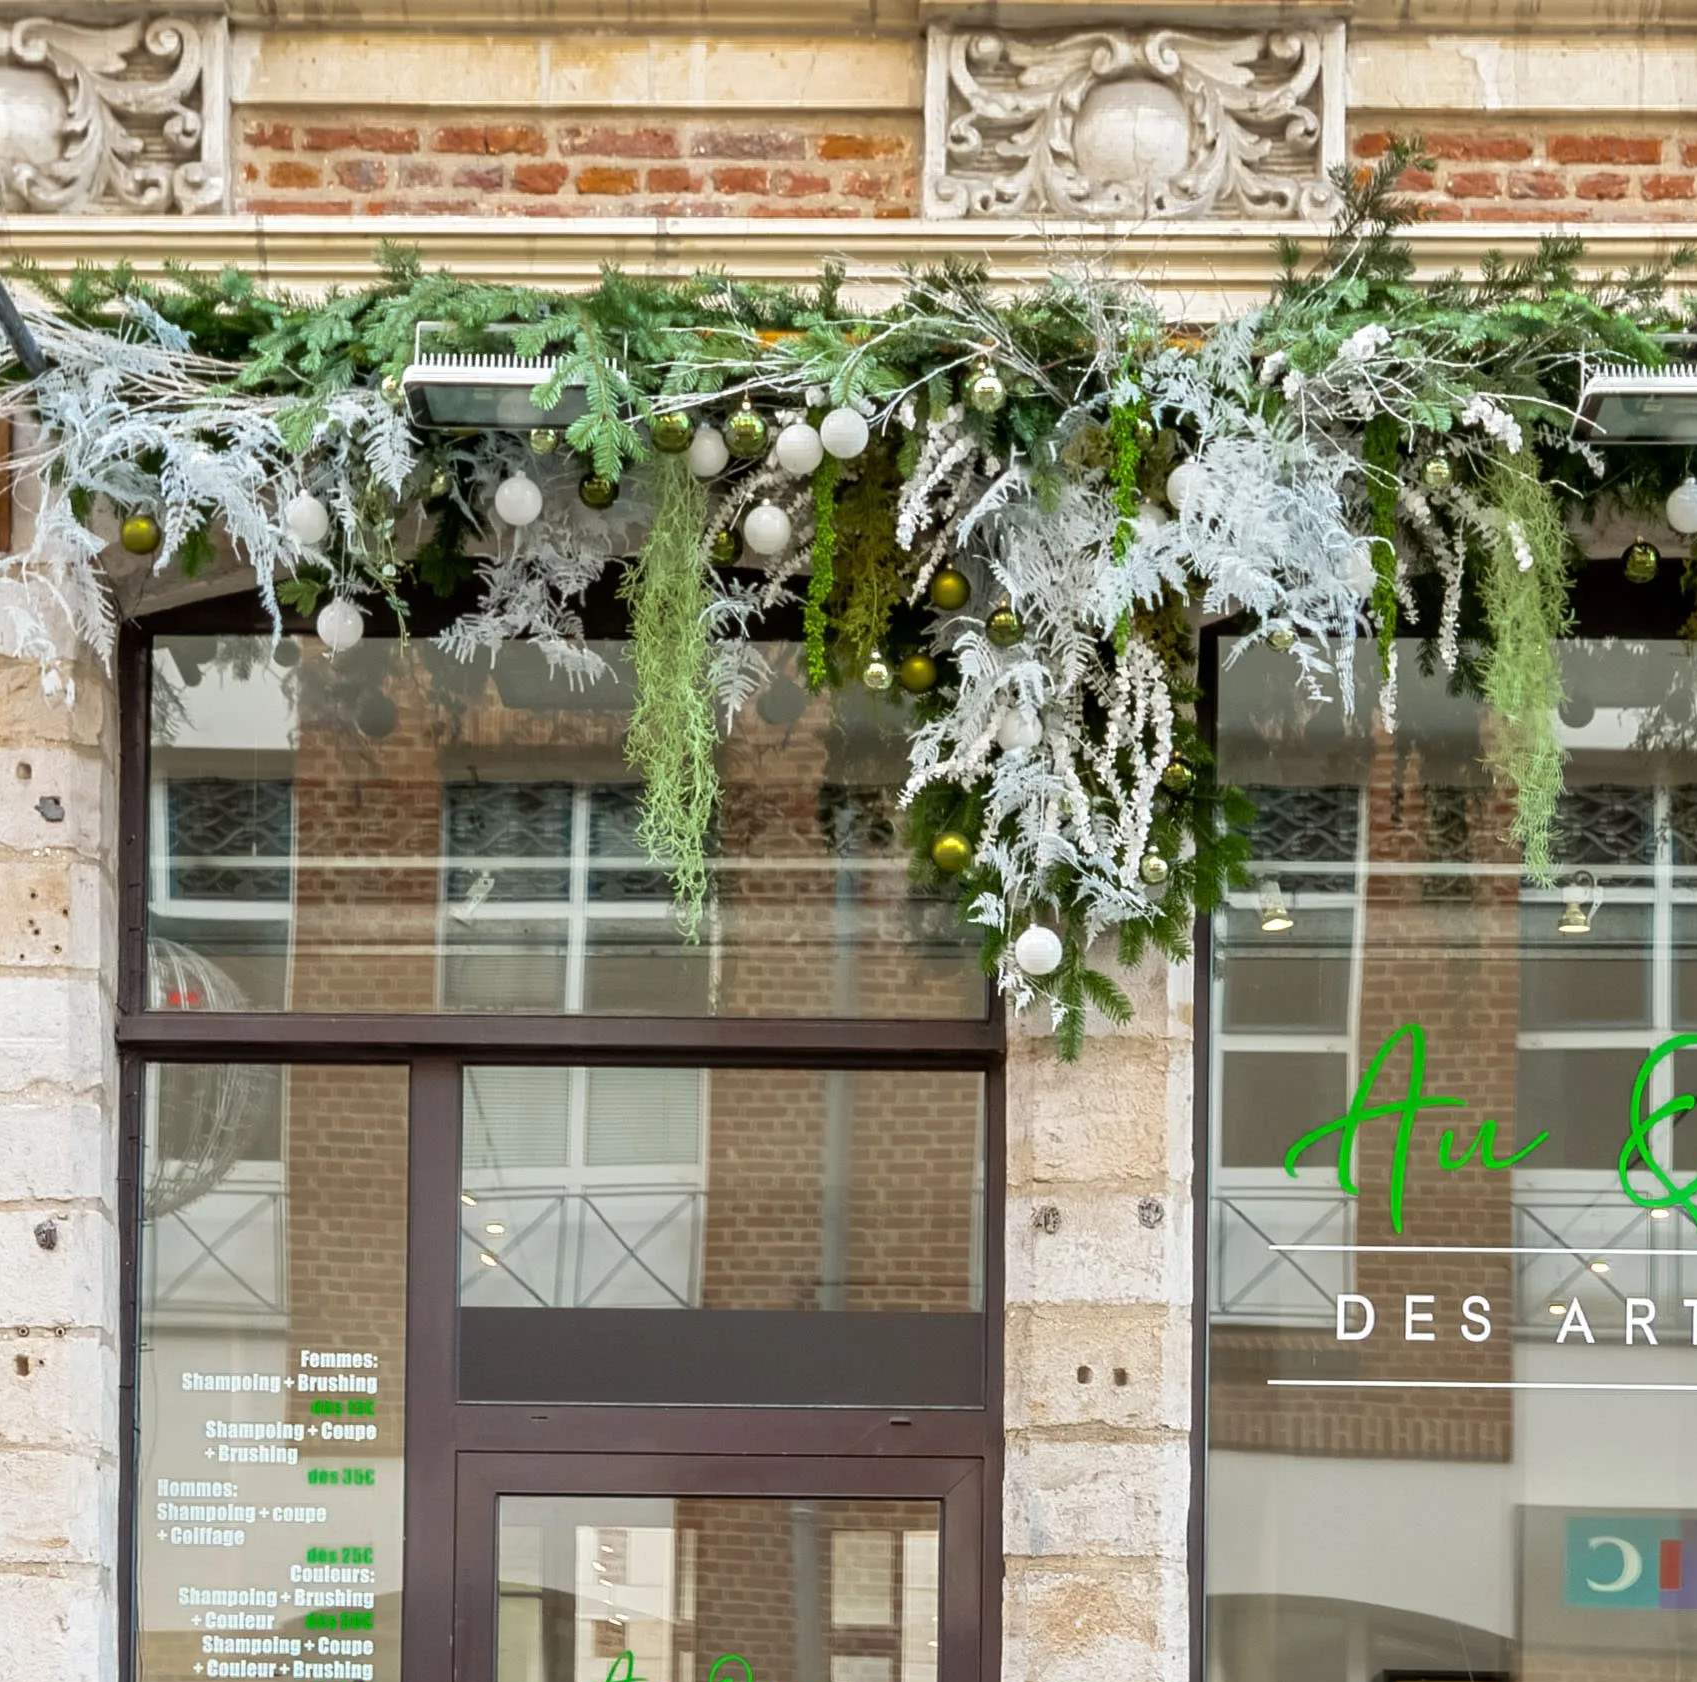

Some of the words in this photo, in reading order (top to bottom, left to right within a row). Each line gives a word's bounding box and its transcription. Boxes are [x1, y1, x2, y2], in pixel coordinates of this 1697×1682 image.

[1285, 1022, 1550, 1235] Au
[1336, 1294, 1492, 1342] DES
[301, 1349, 379, 1369] Femmes:
[182, 1373, 281, 1395] Shampoing
[298, 1374, 378, 1395] Brushing
[205, 1420, 305, 1441] Shampoing
[321, 1421, 377, 1441] Coupe
[218, 1445, 299, 1466] Brushing
[157, 1479, 238, 1498] Hommes:
[157, 1503, 256, 1523] Shampoing
[273, 1507, 327, 1523] coupe
[171, 1526, 246, 1546] Coiffage
[290, 1564, 375, 1584] Couleurs:
[178, 1587, 278, 1608] Shampoing
[294, 1588, 375, 1609] Brushing
[205, 1611, 275, 1630] Couleur
[202, 1636, 301, 1658] Shampoing
[318, 1637, 374, 1657] Coupe
[206, 1660, 277, 1679] Couleur
[293, 1661, 375, 1681] Brushing
